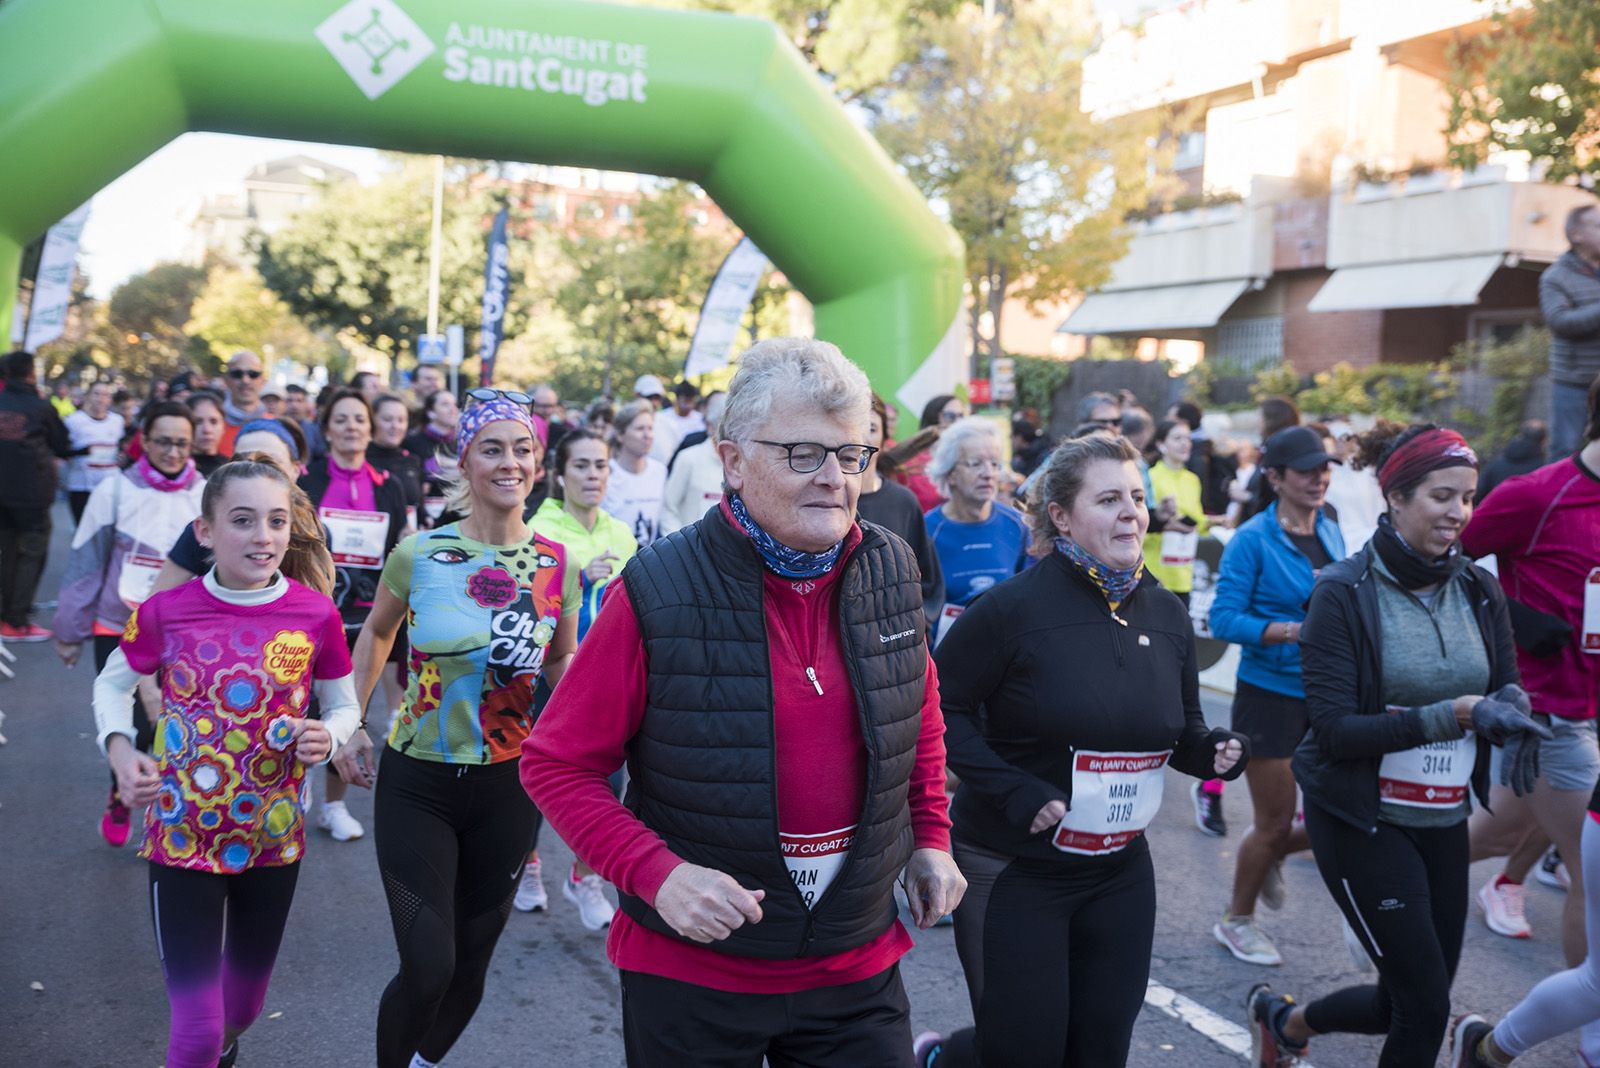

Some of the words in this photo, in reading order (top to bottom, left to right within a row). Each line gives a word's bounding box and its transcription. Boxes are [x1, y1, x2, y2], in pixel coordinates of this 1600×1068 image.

[445, 21, 612, 65] AJUNTAMENT
[616, 42, 648, 69] DE
[443, 46, 648, 107] SantCugat
[474, 574, 513, 588] Chupa
[471, 584, 512, 603] Chups
[1422, 755, 1452, 774] 3144
[1109, 784, 1137, 798] MARIA
[1107, 803, 1133, 823] 3119
[781, 843, 799, 853] NT
[800, 838, 842, 853] CUGAT
[789, 870, 818, 886] OAN
